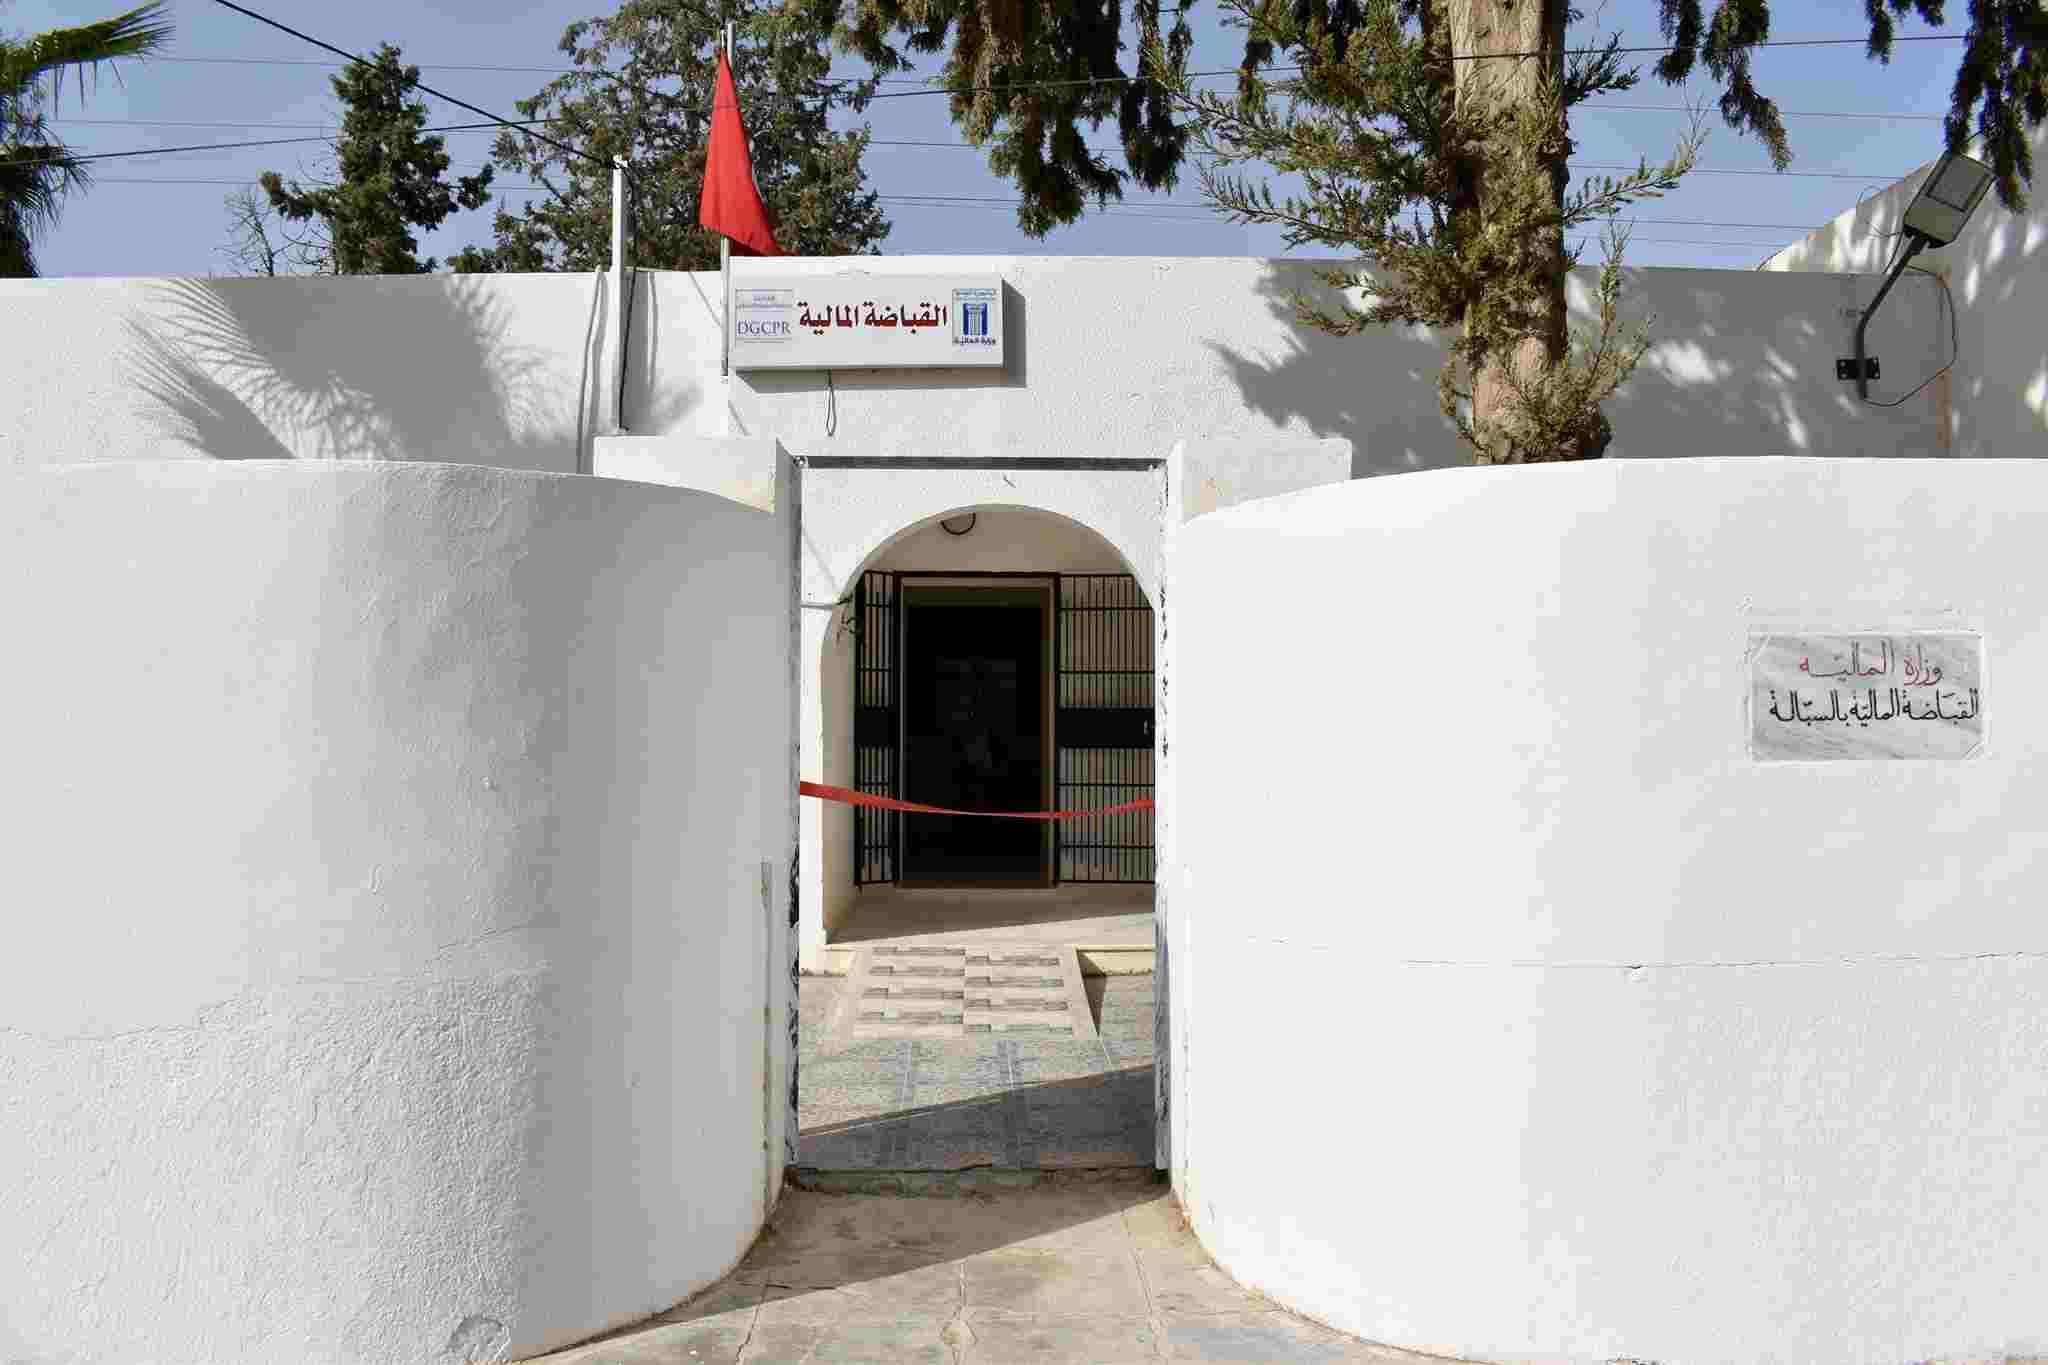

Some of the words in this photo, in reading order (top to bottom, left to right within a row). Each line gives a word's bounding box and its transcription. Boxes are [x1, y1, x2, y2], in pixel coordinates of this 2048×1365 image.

[736, 319, 792, 336] DGCPR
[797, 301, 860, 336] المالية
[863, 300, 948, 335] القباضة
[1904, 643, 1943, 687] وزارة
